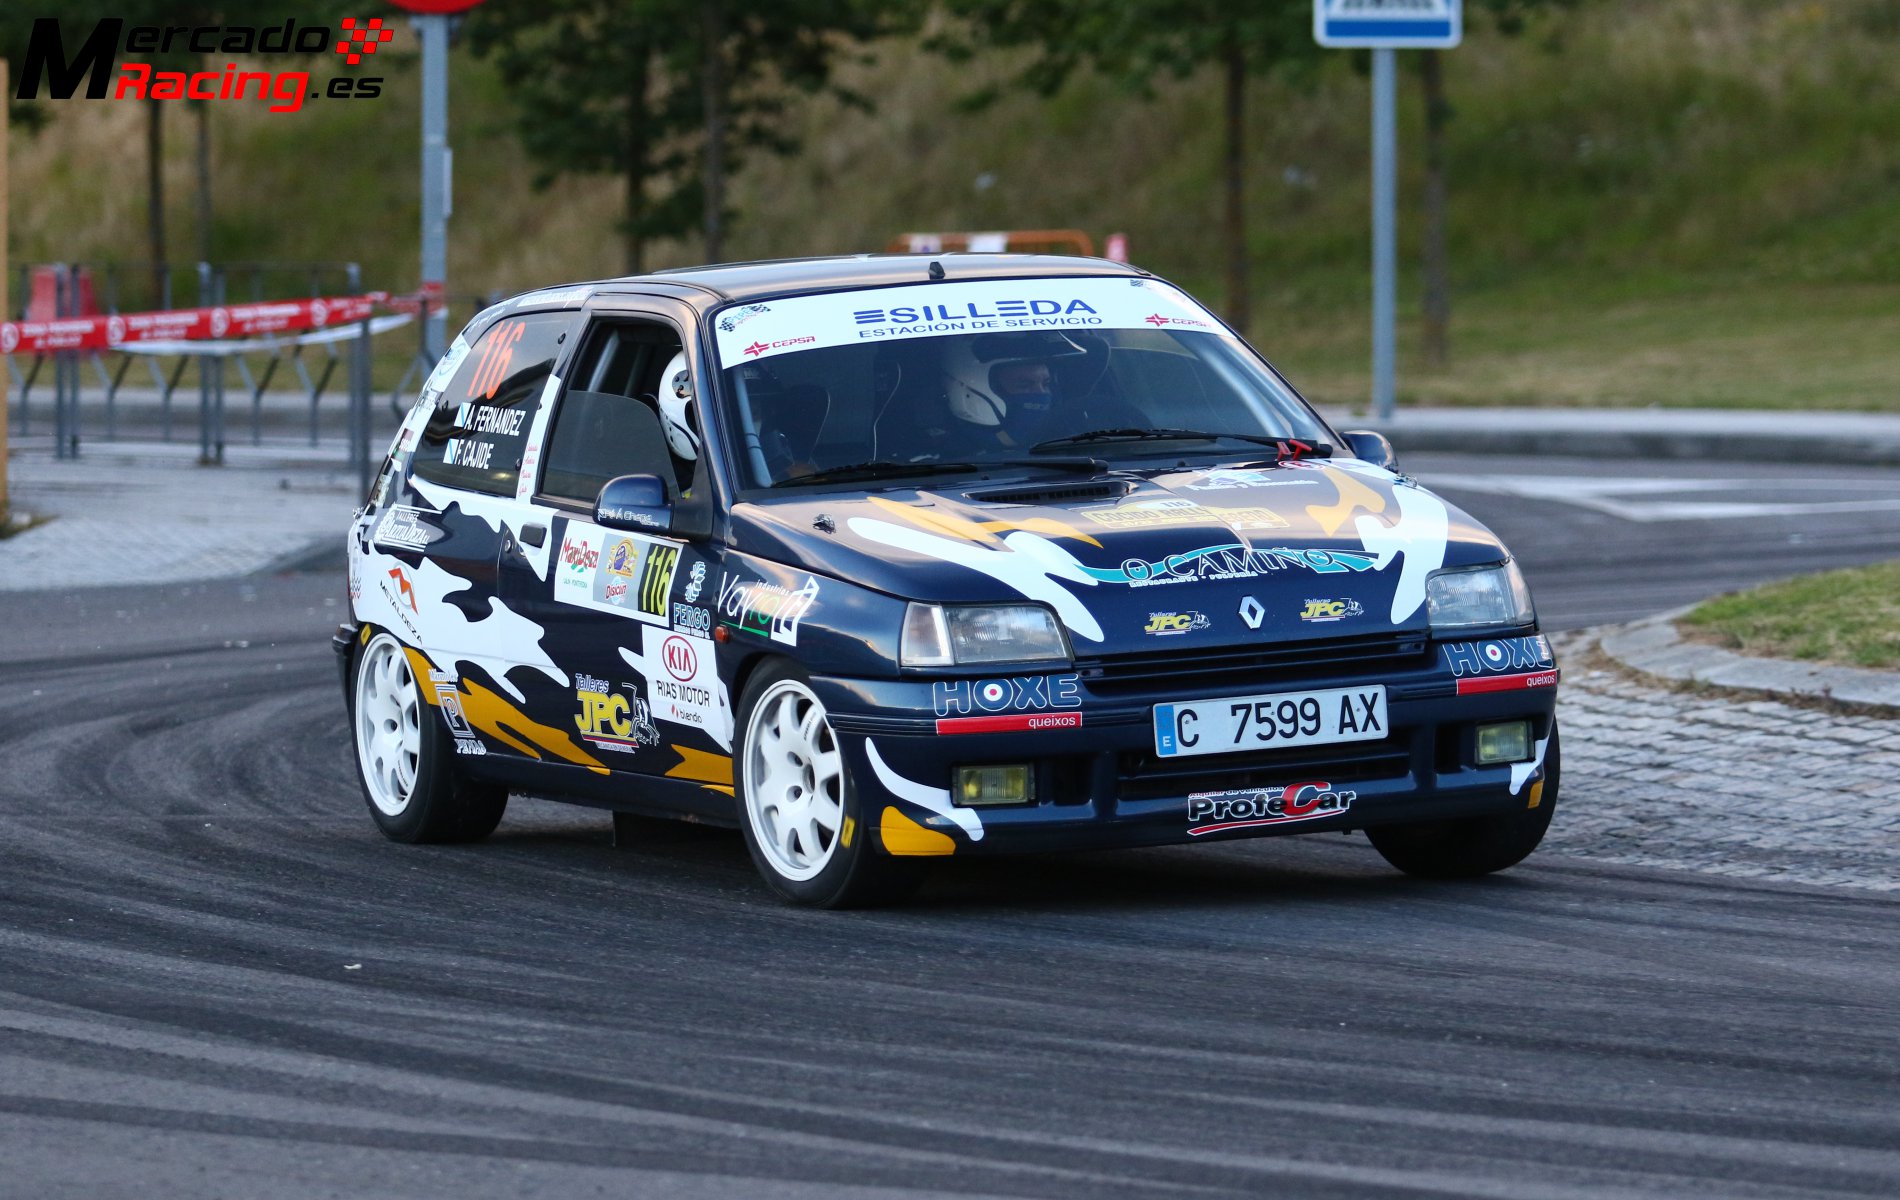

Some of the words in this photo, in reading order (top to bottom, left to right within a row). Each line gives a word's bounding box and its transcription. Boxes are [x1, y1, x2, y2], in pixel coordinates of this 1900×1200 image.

[853, 299, 1098, 324] ESILLEDA
[772, 335, 816, 349] CEPSA
[859, 322, 964, 339] ESTACIÓN
[971, 319, 1000, 329] DE
[1005, 316, 1103, 328] SERVICIO
[467, 321, 526, 399] 116
[472, 405, 526, 437] FERNANDEZ
[463, 440, 494, 470] CAJIDE
[1092, 510, 1161, 523] COCIDO
[1158, 505, 1214, 518] RALLY
[1121, 558, 1153, 581] O
[1163, 547, 1335, 577] CAMIÑO
[642, 546, 676, 616] 116
[379, 580, 423, 645] METALDEZA
[673, 602, 711, 631] FERGO
[1144, 614, 1191, 631] JPC
[1300, 601, 1345, 617] JPC
[667, 645, 693, 673] KIA
[1442, 636, 1554, 677] HOXE
[575, 673, 609, 693] Talleres
[656, 680, 678, 699] RIAS
[679, 685, 710, 708] MOTOR
[933, 673, 1082, 717] HOXE
[1527, 674, 1555, 687] queixos
[574, 690, 632, 737] JPC
[1028, 715, 1076, 730] queixos
[1162, 735, 1172, 747] E
[1177, 709, 1199, 747] C
[1231, 697, 1321, 743] 7599
[1338, 693, 1382, 735] AX
[1187, 781, 1356, 822] ProfeCar
